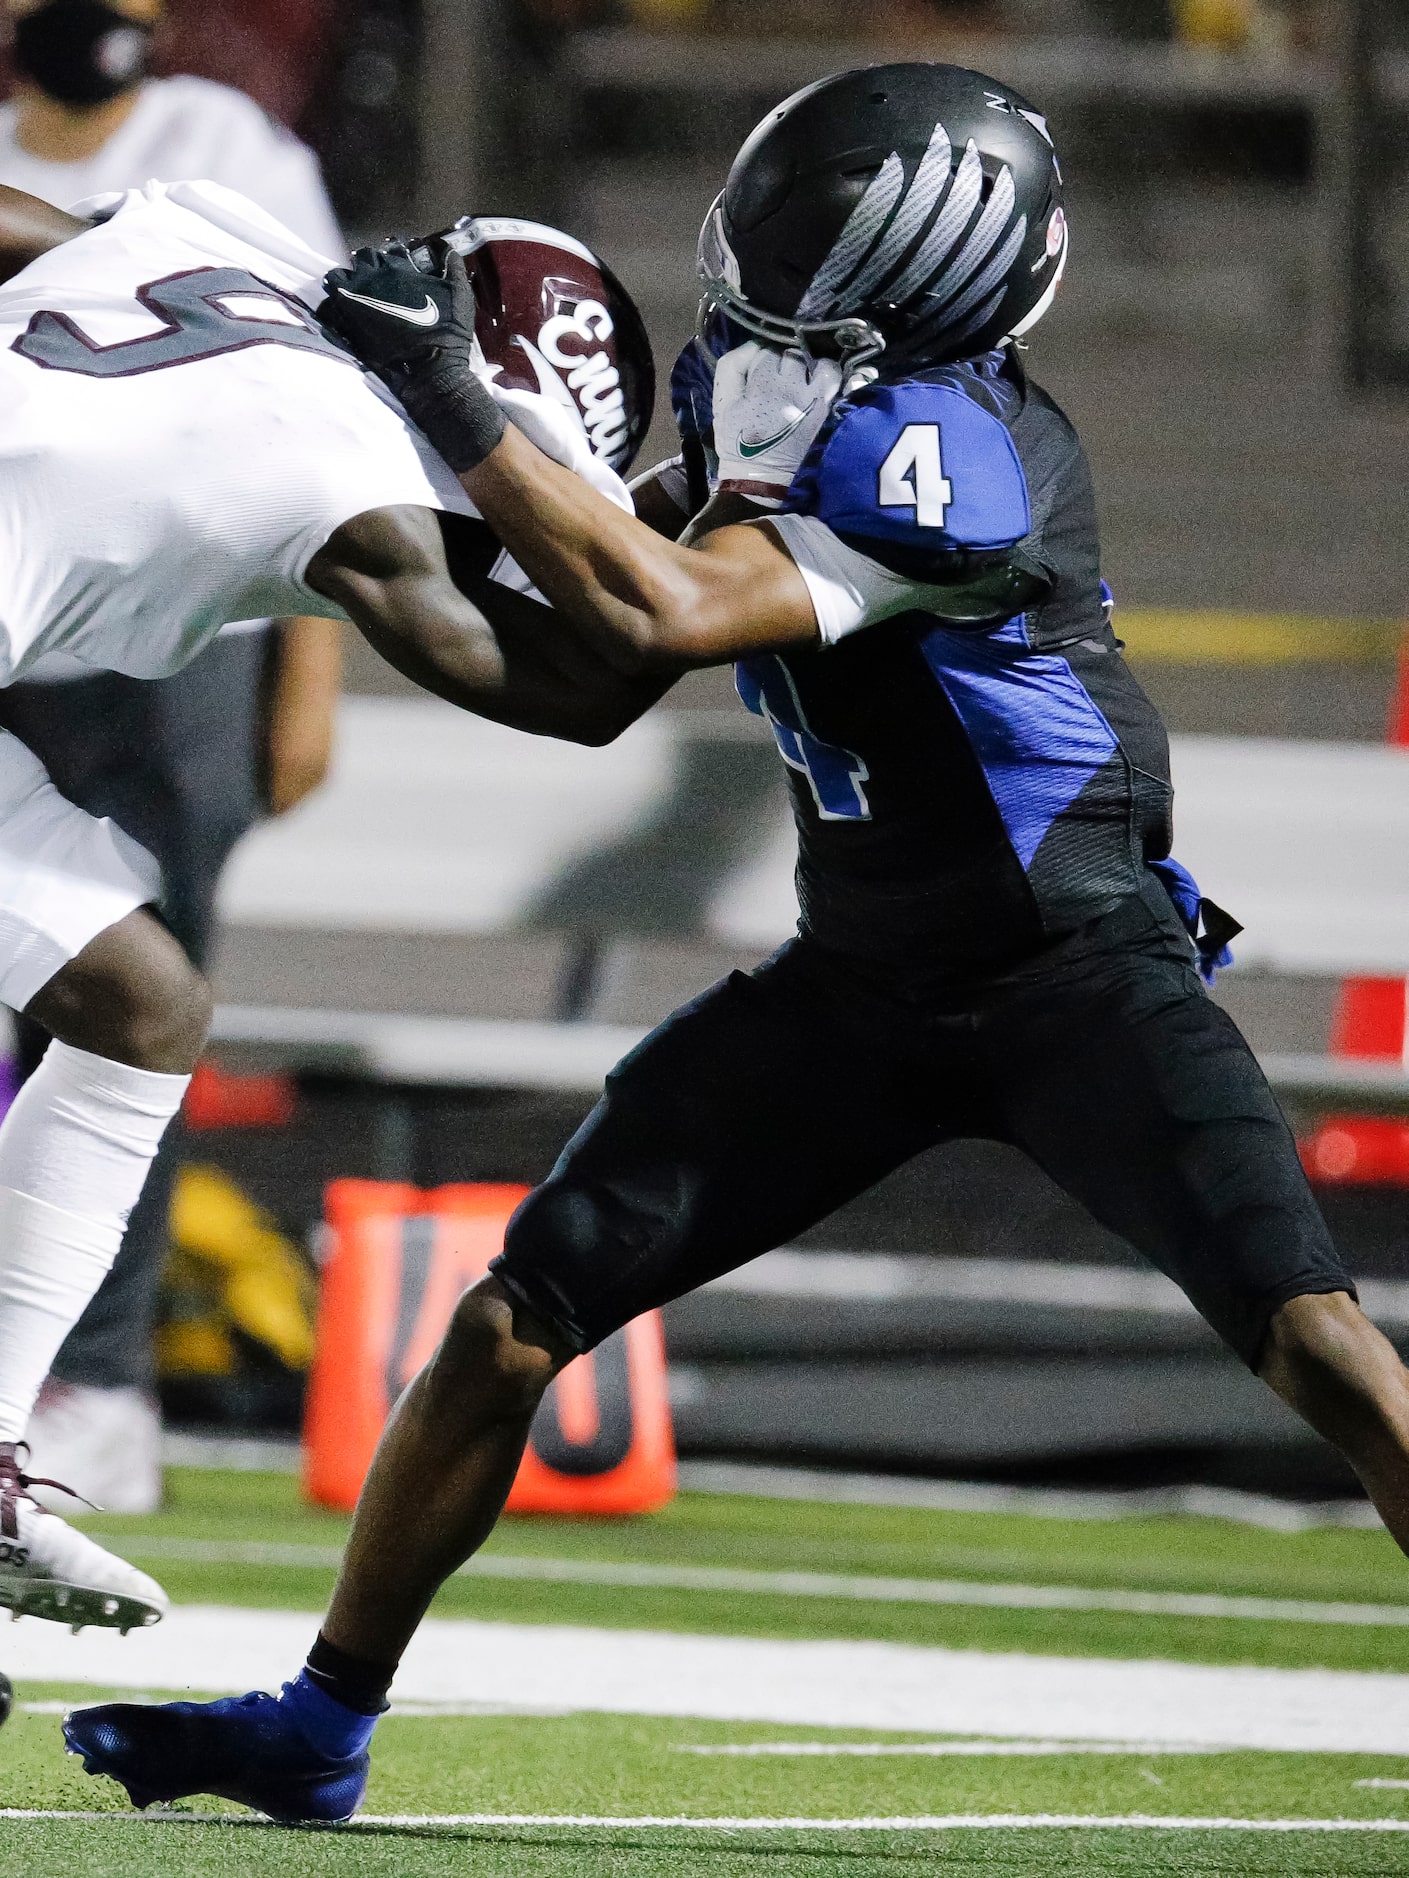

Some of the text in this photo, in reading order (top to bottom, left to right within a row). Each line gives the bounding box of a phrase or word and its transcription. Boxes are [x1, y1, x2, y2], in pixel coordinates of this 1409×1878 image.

[8, 265, 364, 379] 9
[878, 421, 953, 527] 4
[734, 653, 872, 821] 4
